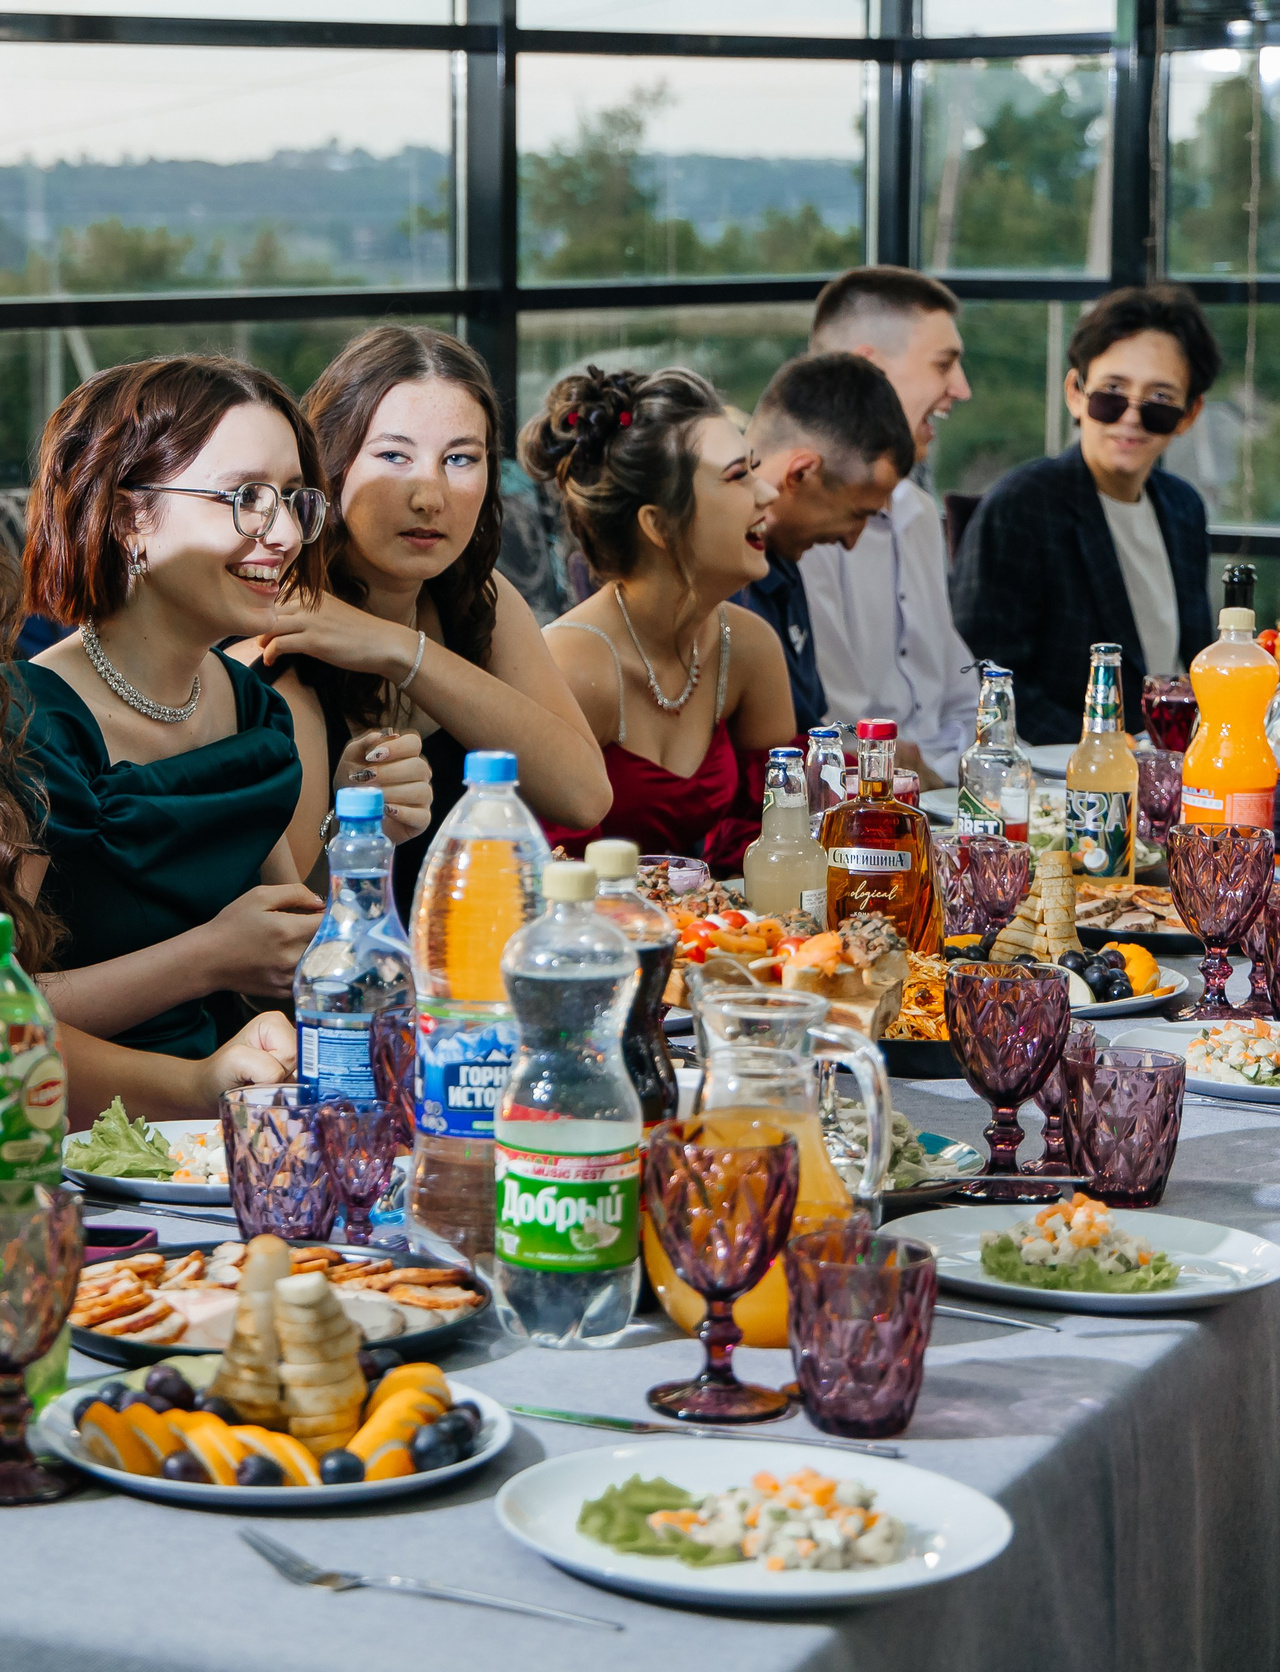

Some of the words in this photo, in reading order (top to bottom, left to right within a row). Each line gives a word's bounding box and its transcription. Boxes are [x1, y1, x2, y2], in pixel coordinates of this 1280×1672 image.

[959, 817, 998, 836] RRET
[459, 1065, 508, 1087] ГОРН
[531, 1164, 571, 1180] MUSIC
[573, 1167, 606, 1181] FEST
[502, 1179, 625, 1233] Добрый
